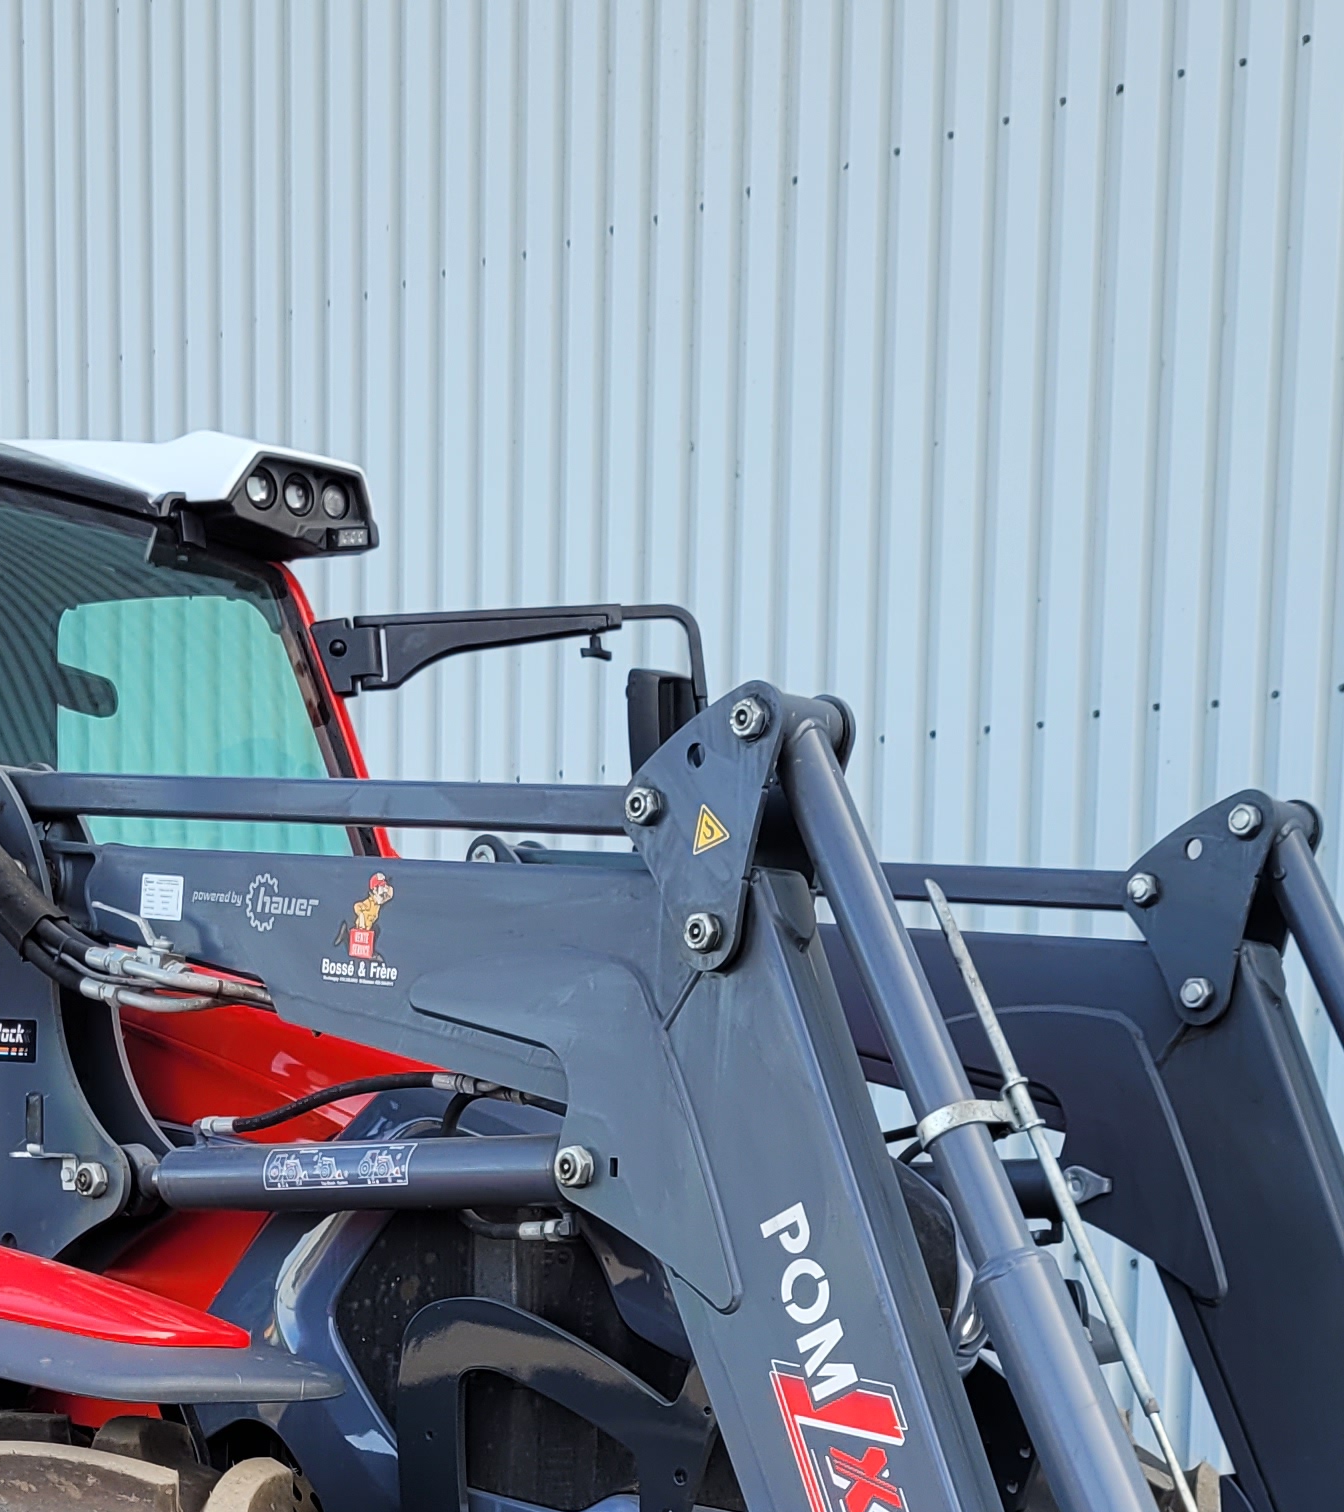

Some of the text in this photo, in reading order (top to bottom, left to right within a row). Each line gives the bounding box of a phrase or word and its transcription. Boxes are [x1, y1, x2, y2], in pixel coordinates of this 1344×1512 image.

[192, 890, 243, 907] powered by
[256, 886, 320, 917] hauer
[321, 957, 398, 980] Bossé & Frère
